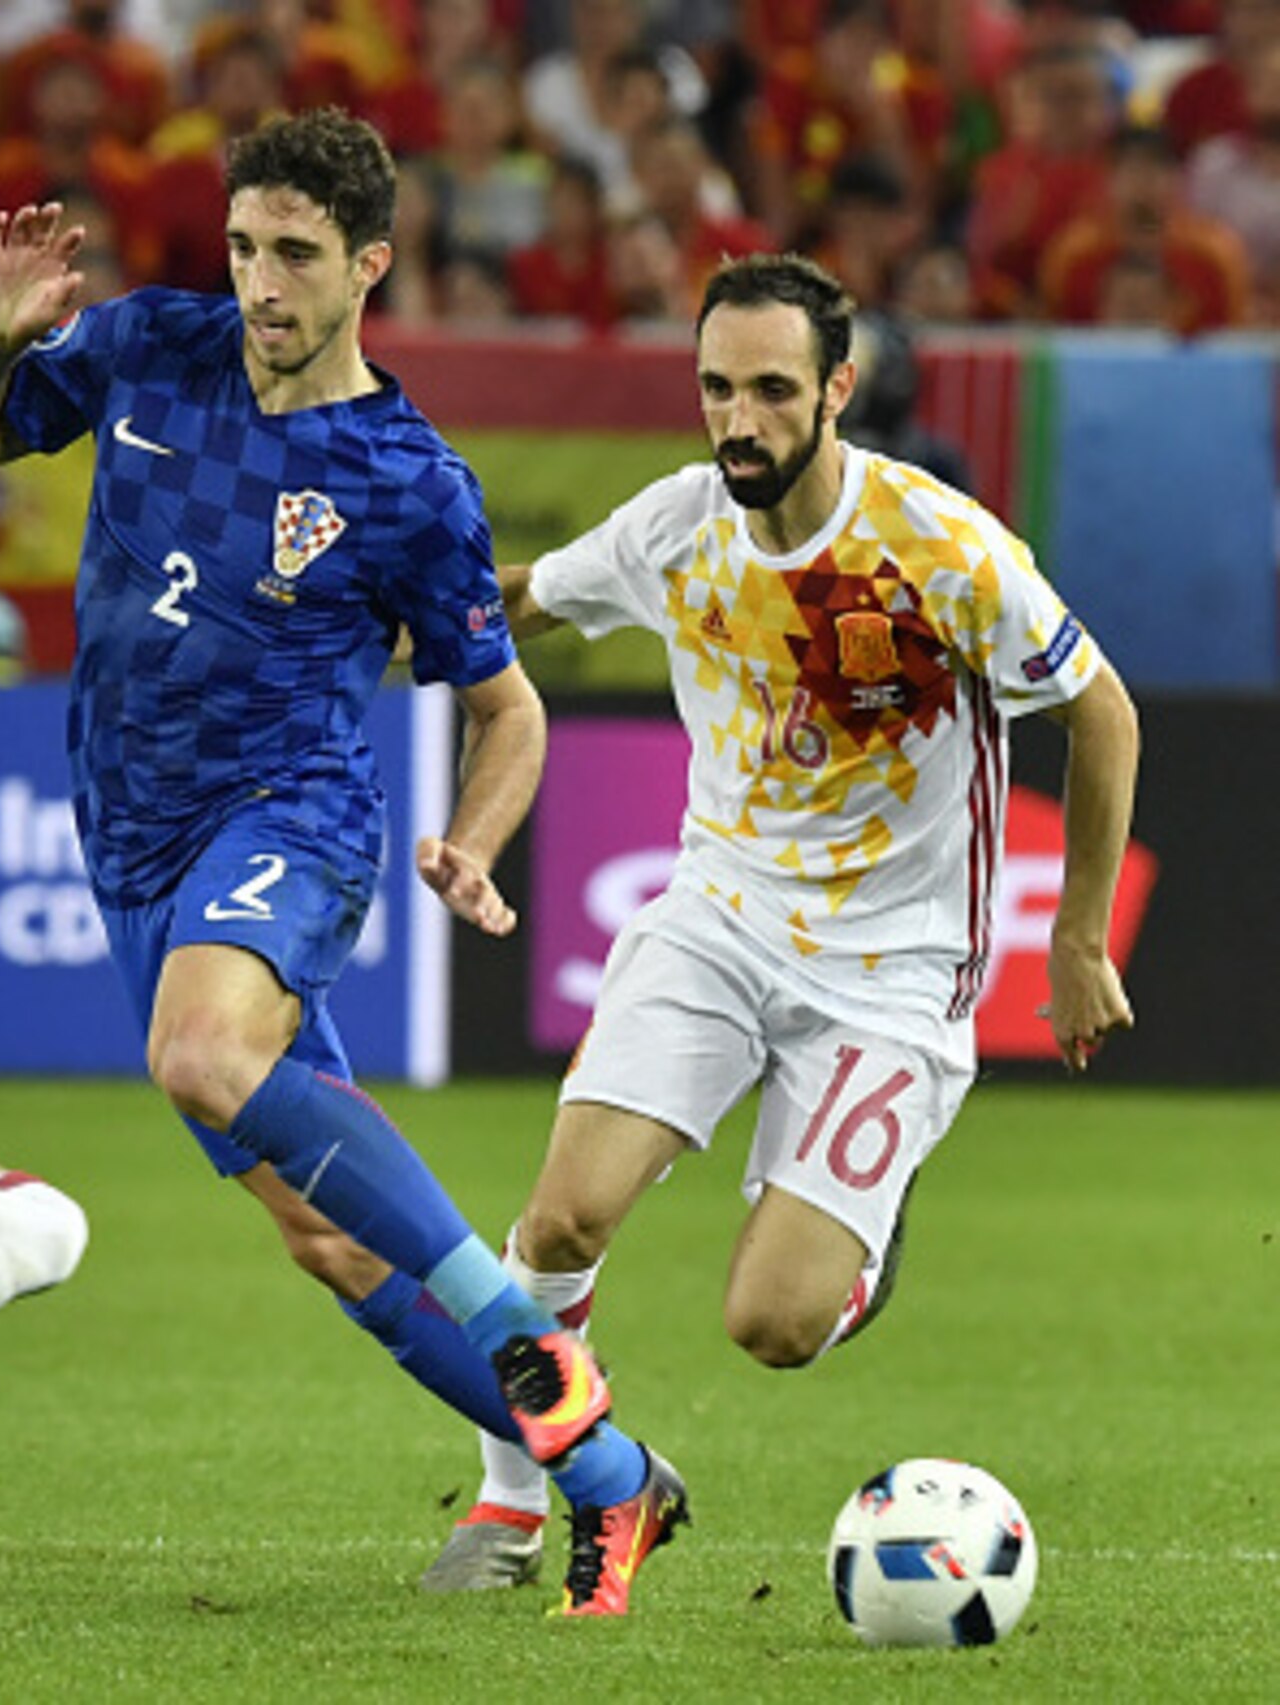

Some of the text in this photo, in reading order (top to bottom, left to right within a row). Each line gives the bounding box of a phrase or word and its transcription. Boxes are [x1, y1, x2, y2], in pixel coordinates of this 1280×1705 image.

[150, 552, 198, 627] 2
[753, 680, 830, 770] 16
[227, 853, 288, 914] 2
[795, 1044, 915, 1191] 16
